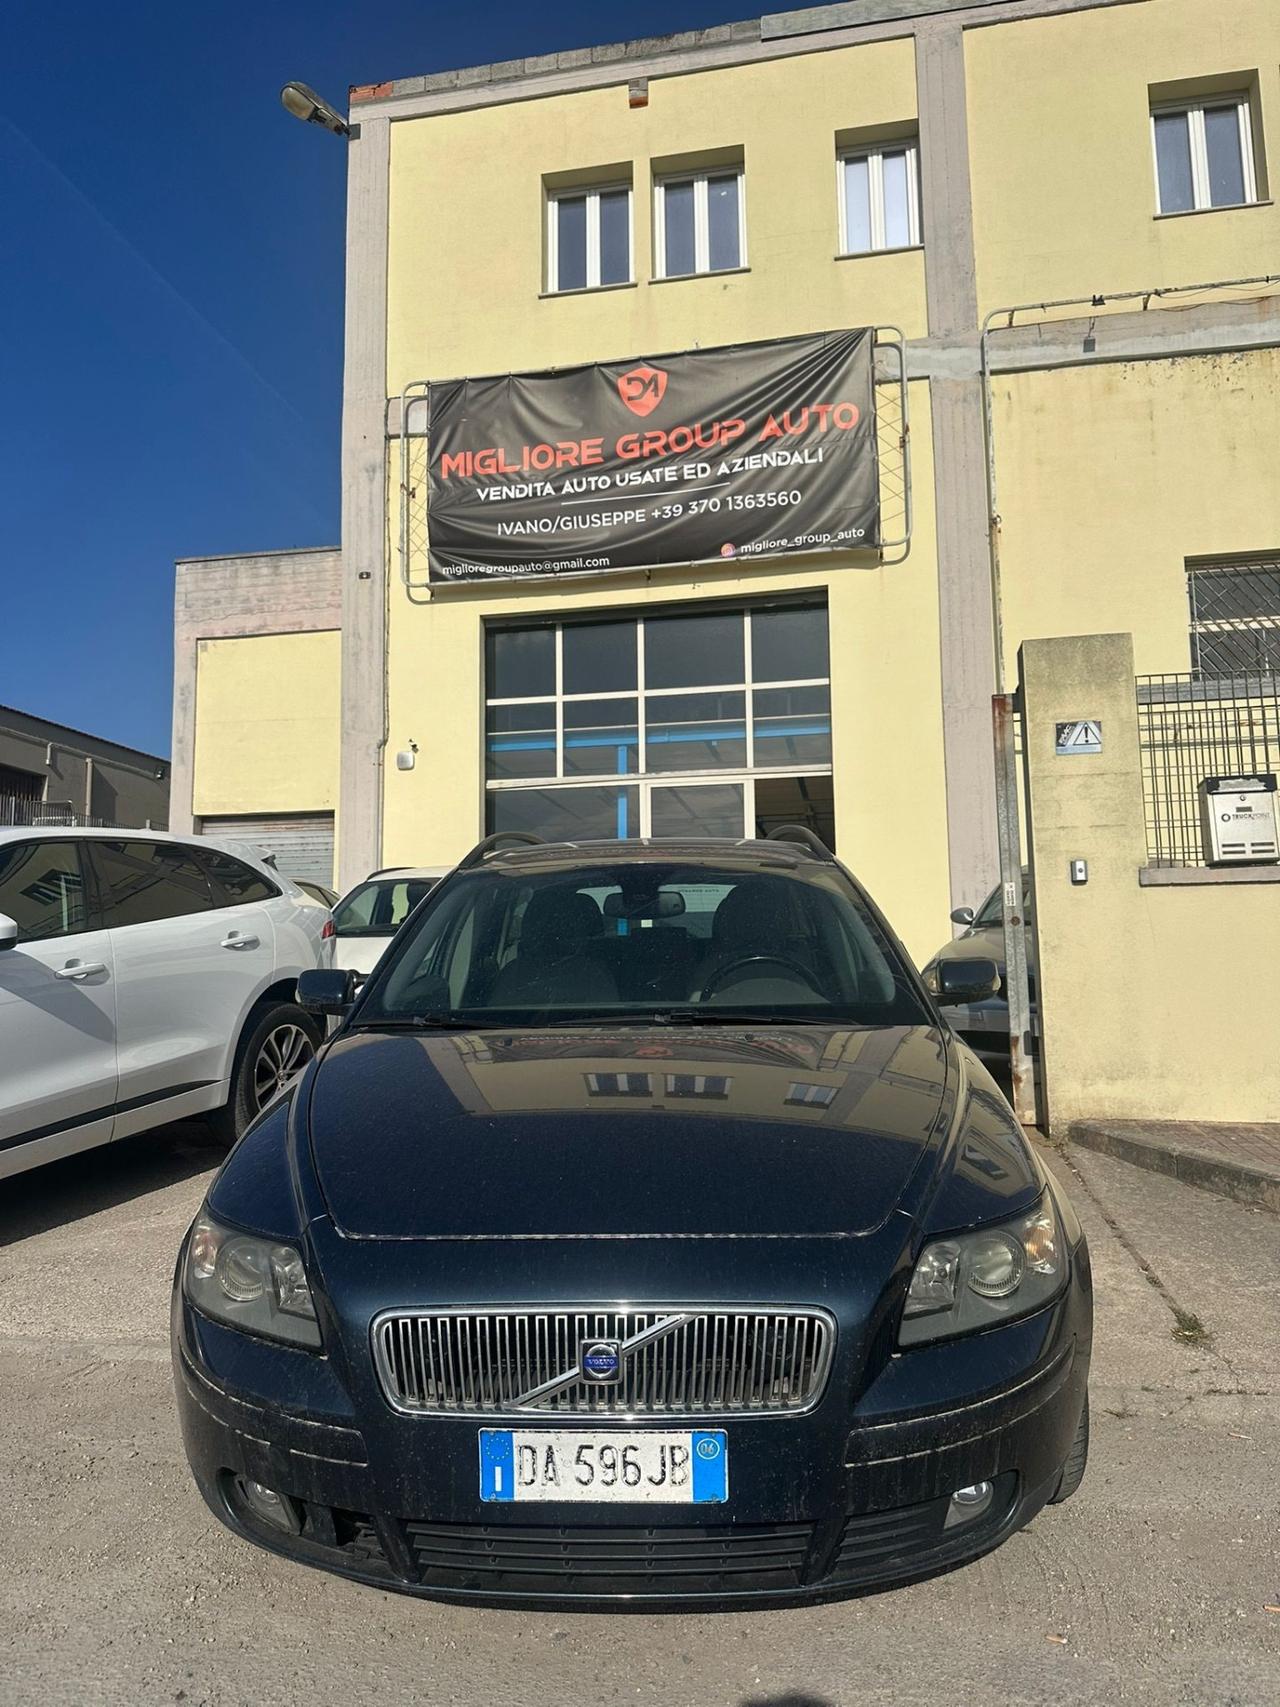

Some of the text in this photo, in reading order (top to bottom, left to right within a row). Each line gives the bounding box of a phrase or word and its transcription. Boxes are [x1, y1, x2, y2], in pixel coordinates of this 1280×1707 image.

[441, 402, 860, 480] MIGLIORE GROUP AUTO
[476, 447, 824, 501] VENDITA AUTO USATE ED AZIENDALI
[497, 490, 802, 536] IVANO/GIUSEPPE +39 370 1363560
[741, 528, 865, 554] migliore_group_auto
[442, 556, 610, 576] miglioregroupauto@gmail.com
[517, 1444, 560, 1487] DA
